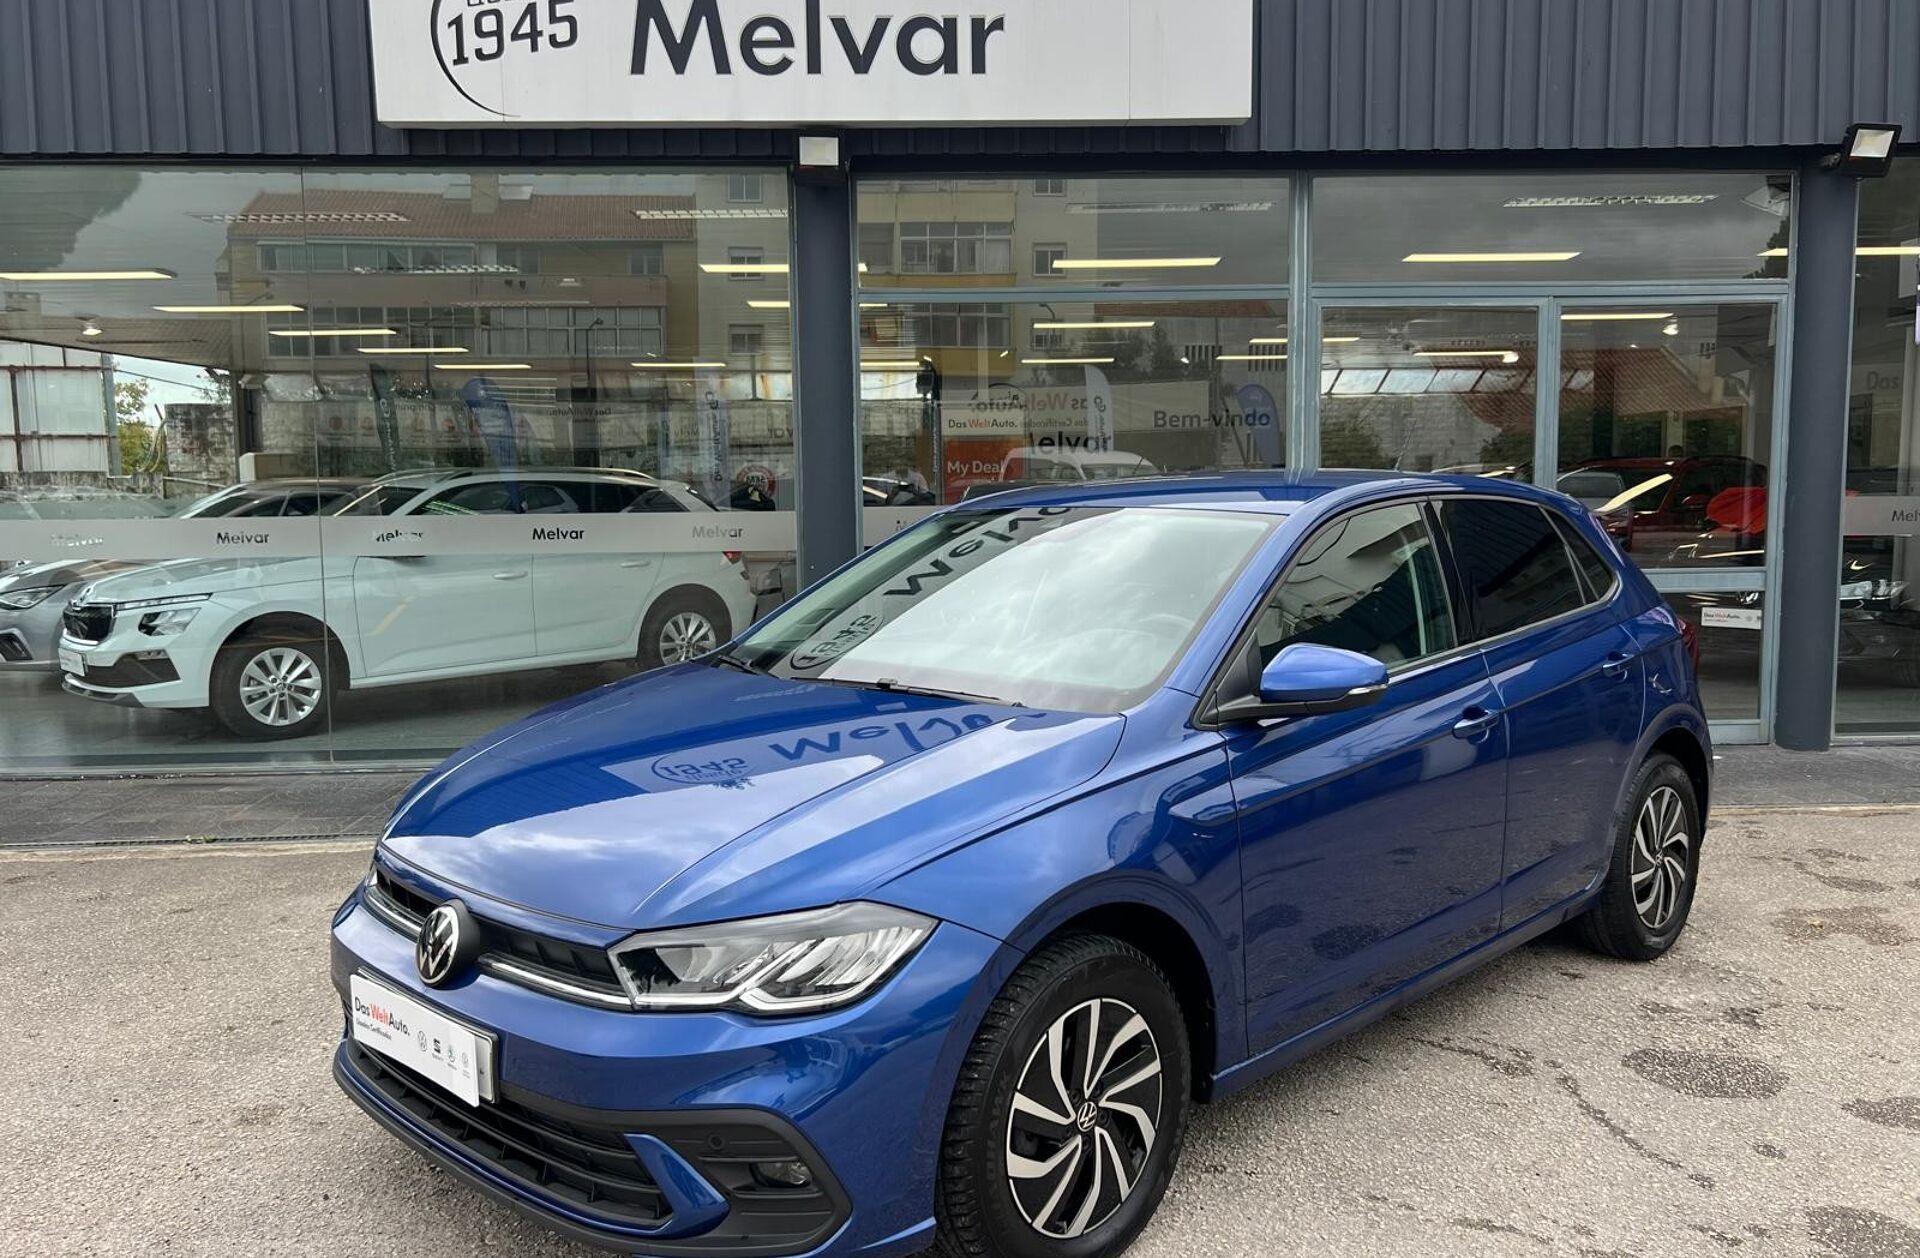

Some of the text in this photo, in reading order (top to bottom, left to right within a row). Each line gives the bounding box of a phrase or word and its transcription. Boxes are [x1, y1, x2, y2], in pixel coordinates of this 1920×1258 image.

[447, 0, 578, 67] 1945
[629, 0, 1005, 76] Melvar
[1153, 408, 1272, 428] Bem-vindo
[1030, 430, 1112, 456] elvar
[947, 461, 969, 478] My
[215, 531, 270, 545] Melvar
[531, 527, 585, 541] Melvar
[691, 525, 744, 539] Melvar
